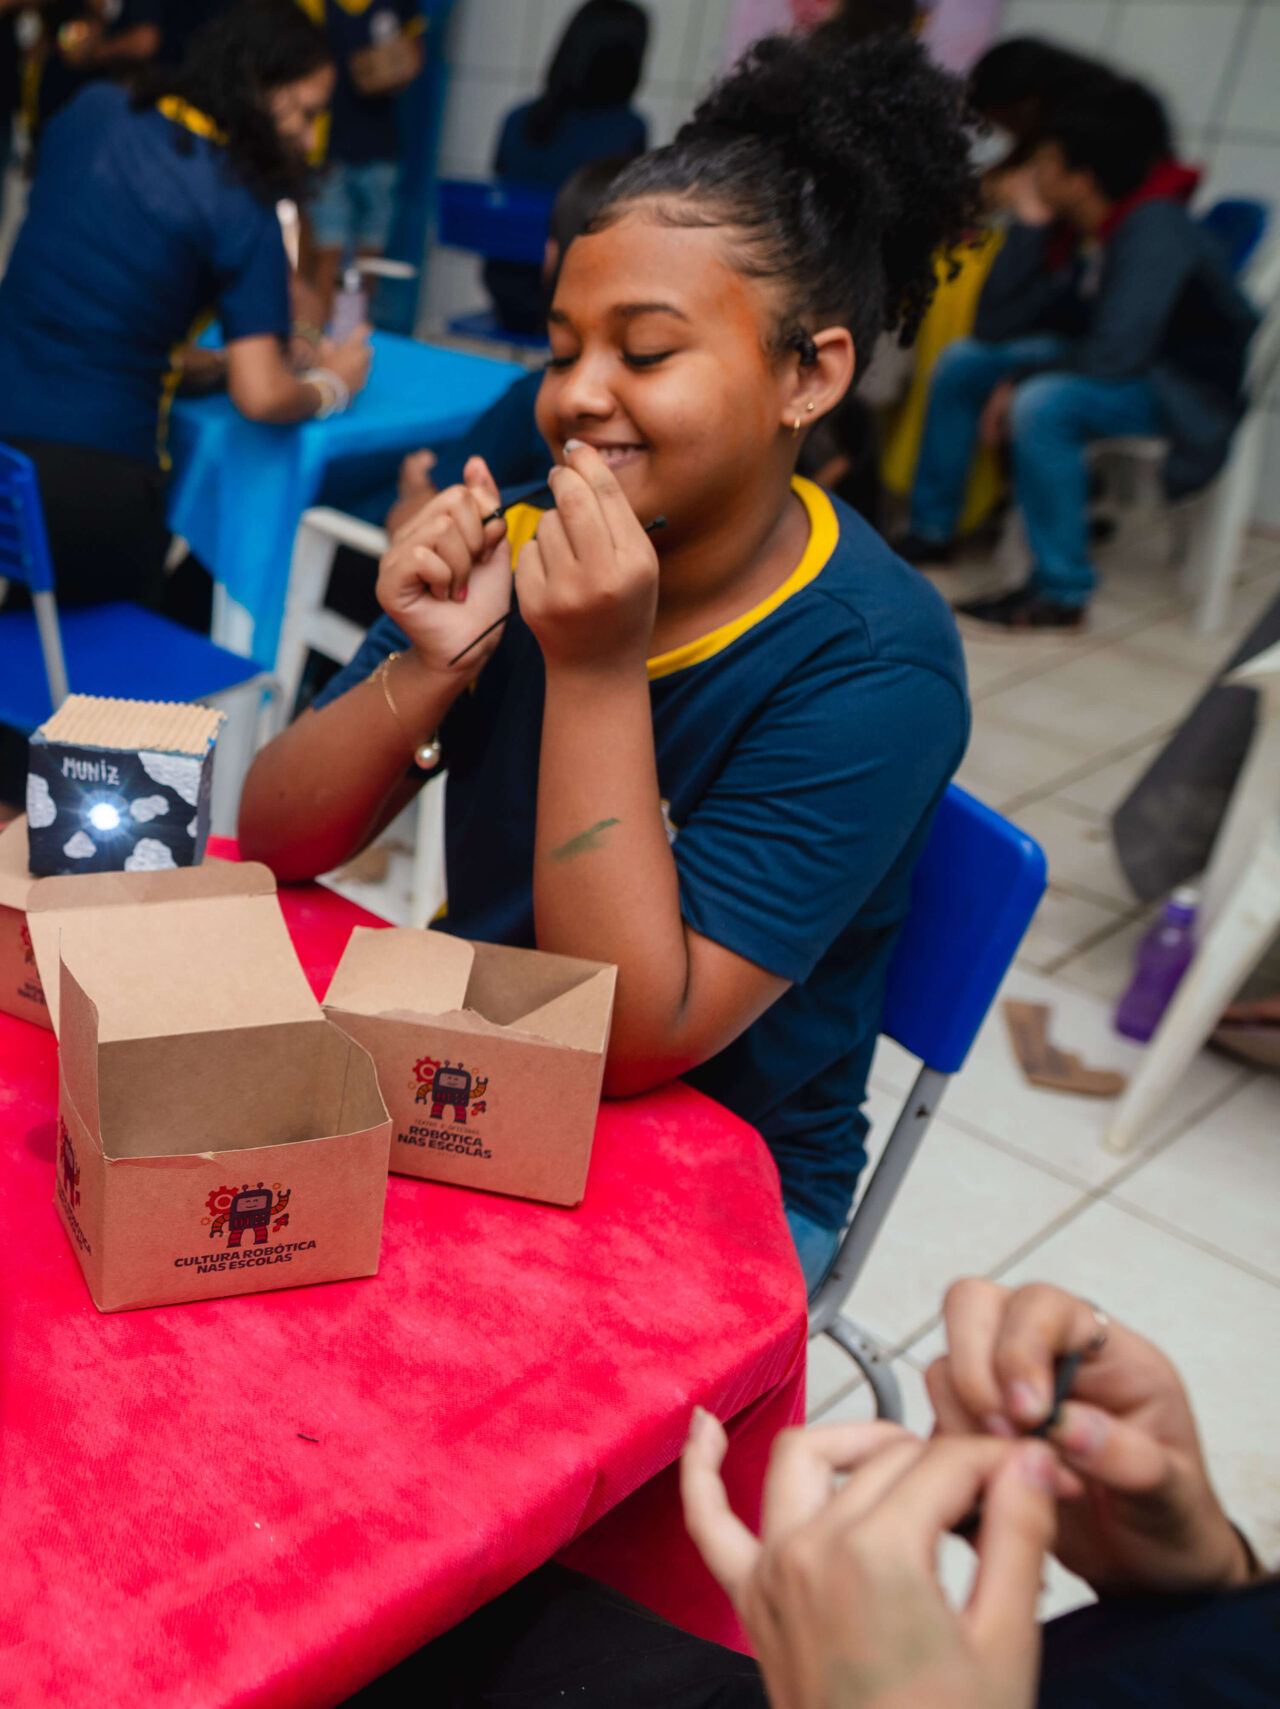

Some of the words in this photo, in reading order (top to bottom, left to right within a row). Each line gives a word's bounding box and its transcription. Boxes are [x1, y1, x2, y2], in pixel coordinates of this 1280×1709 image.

[397, 1133, 426, 1147] NAS
[428, 1139, 492, 1159] ESCOLAS
[409, 1125, 483, 1147] ROBÓTICA
[174, 1252, 240, 1267] CULTURA
[243, 1240, 316, 1258] ROBÓTICA
[197, 1263, 226, 1274] NAS
[229, 1253, 292, 1270] ESCOLAS
